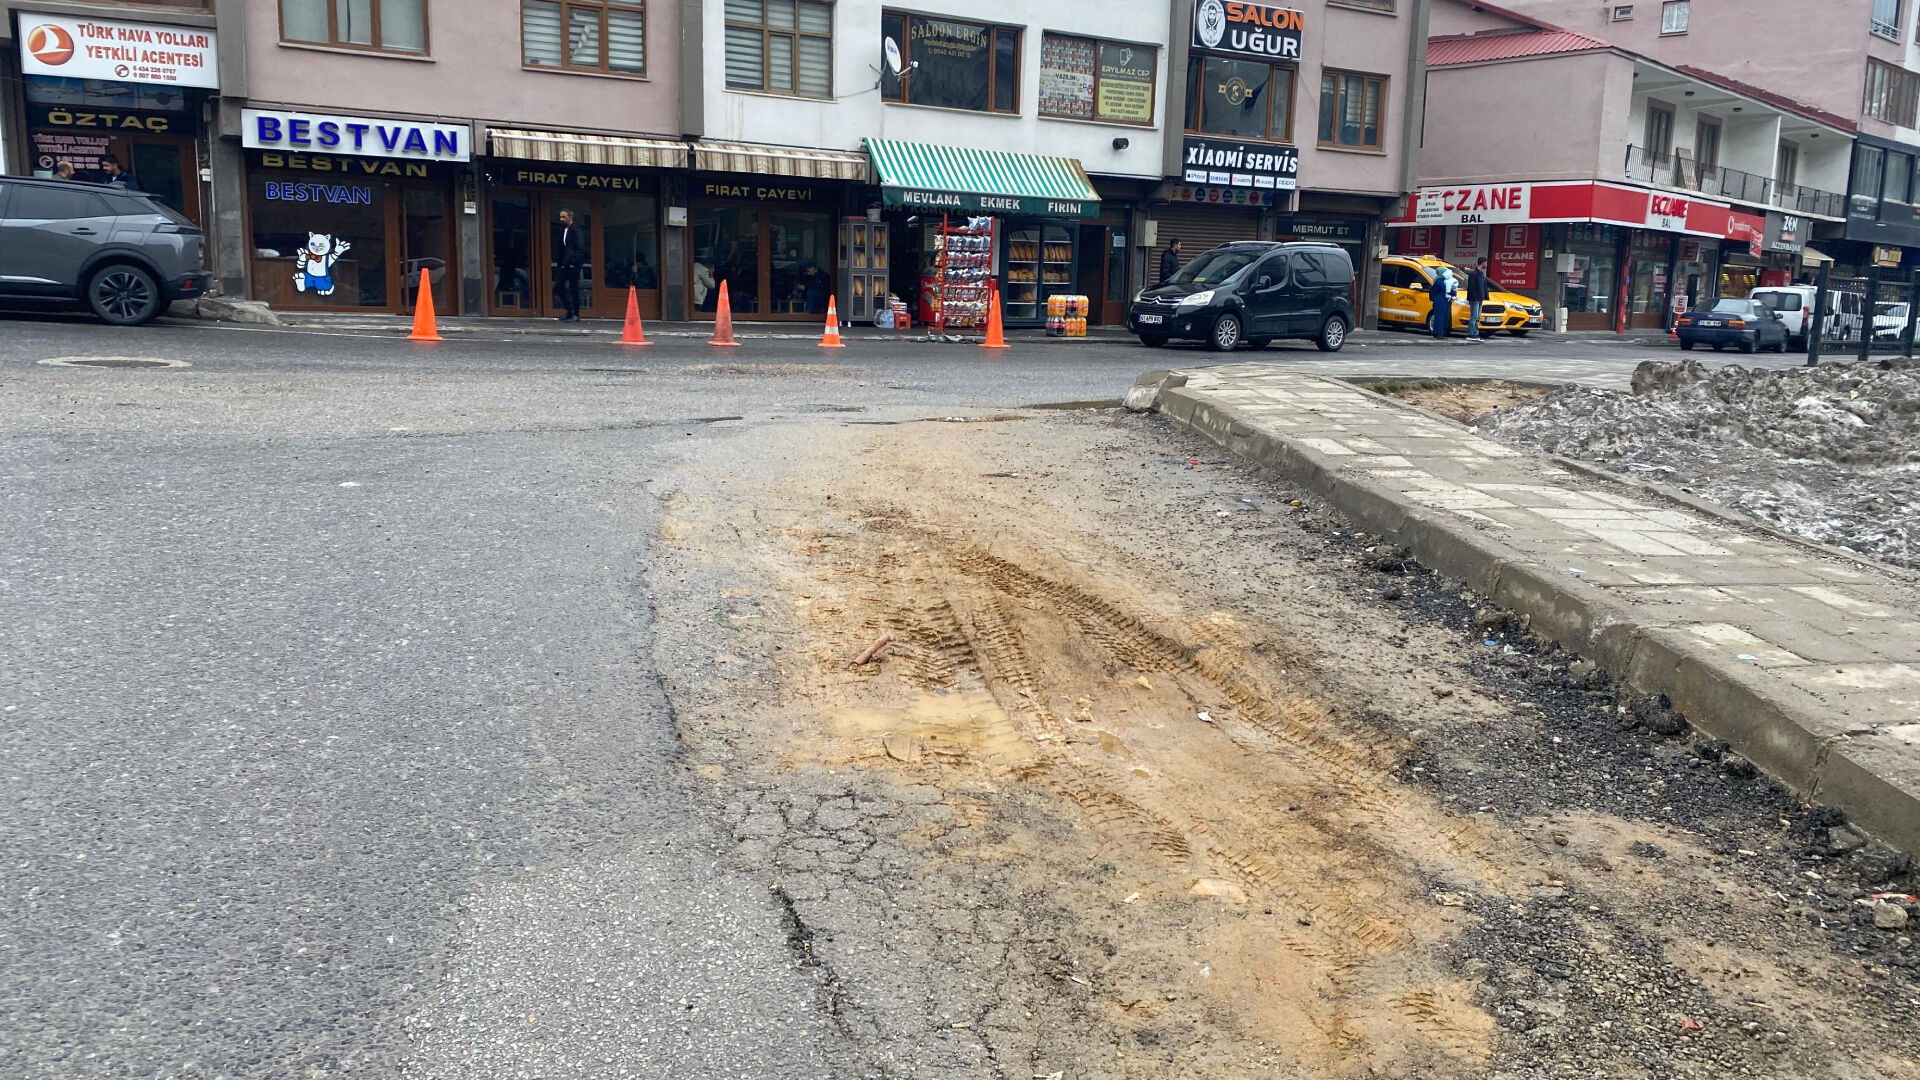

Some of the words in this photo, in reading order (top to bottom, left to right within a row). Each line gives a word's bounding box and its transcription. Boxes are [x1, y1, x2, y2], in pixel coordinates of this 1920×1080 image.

[1227, 2, 1304, 30] SALON
[77, 23, 114, 40] TÜRK
[118, 28, 152, 44] HAVA
[155, 31, 209, 48] YOLLARI
[911, 23, 952, 40] SALOON
[1231, 27, 1298, 57] UĞUR
[85, 45, 137, 61] YETKİLİ
[141, 50, 203, 67] ACENTESİ
[48, 108, 169, 133] ÖZTAÇ
[1245, 150, 1298, 173] SERVİS
[517, 170, 567, 185] FIRAT
[576, 174, 640, 190] ÇAYEVİ
[265, 181, 371, 205] BESTVAN
[705, 184, 750, 198] FIRAT
[756, 187, 812, 201] ÇAYEVİ
[903, 191, 961, 206] MEVLANA
[980, 196, 1021, 210] EKMEK
[1048, 202, 1082, 214] FIRINI
[1651, 195, 1689, 219] ECZANE
[1461, 214, 1484, 224] BAL
[1661, 218, 1671, 229] BAL
[1783, 215, 1799, 232] ZEN
[1292, 224, 1334, 234] MERMUT
[1337, 227, 1350, 235] ET
[1415, 229, 1427, 246] E
[1461, 229, 1473, 245] E
[1509, 227, 1523, 245] E
[1495, 252, 1535, 260] ECZANE
